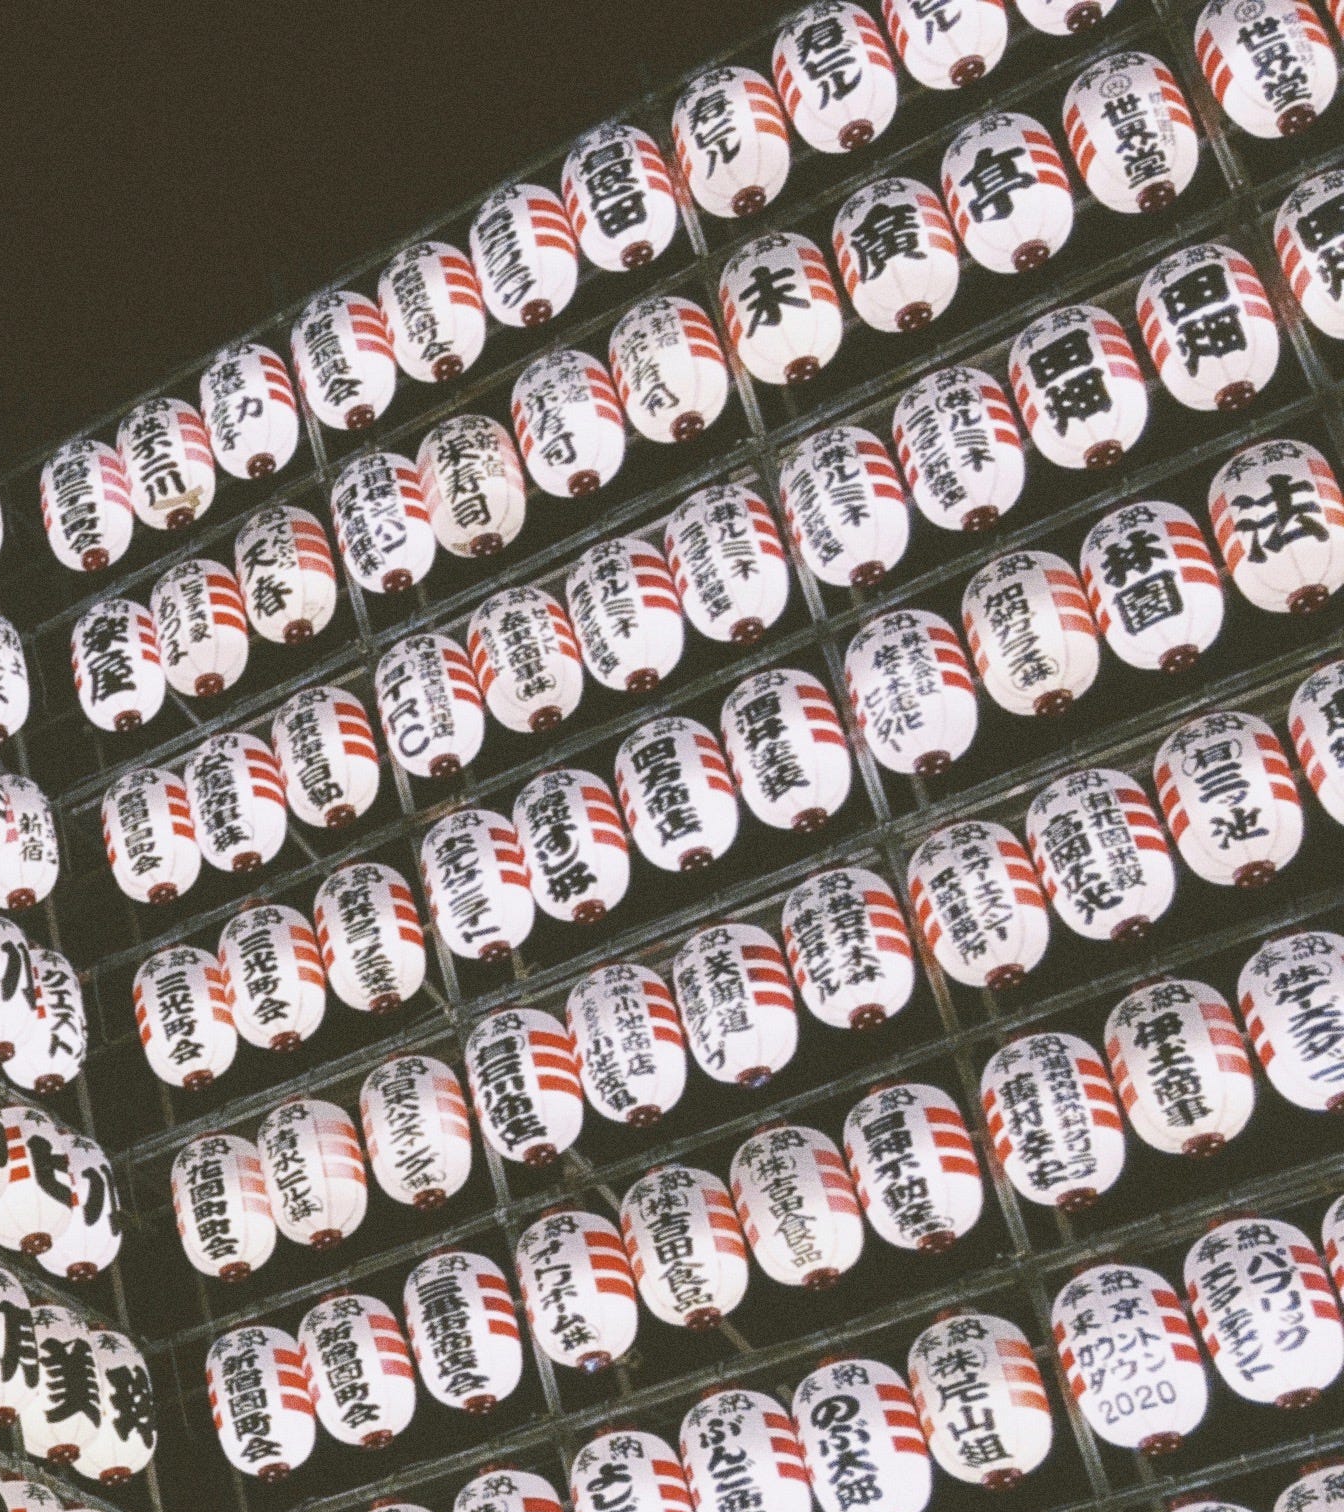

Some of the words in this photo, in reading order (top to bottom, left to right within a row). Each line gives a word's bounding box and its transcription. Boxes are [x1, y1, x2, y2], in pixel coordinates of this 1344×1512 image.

[1238, 17, 1311, 112] 世界堂
[1101, 93, 1170, 188] 世界堂
[477, 431, 505, 477] 新宿
[1231, 474, 1330, 563] 法
[242, 541, 292, 618] 天春
[901, 631, 942, 697] 株式会社
[18, 812, 44, 863] 新宿
[238, 930, 291, 1025] 三光町会
[704, 952, 753, 1036] 笑顔道
[155, 971, 206, 1065] 三光町会
[1071, 1299, 1147, 1336] 東京
[1075, 1326, 1161, 1369] カウント
[1099, 1381, 1177, 1425] 2020
